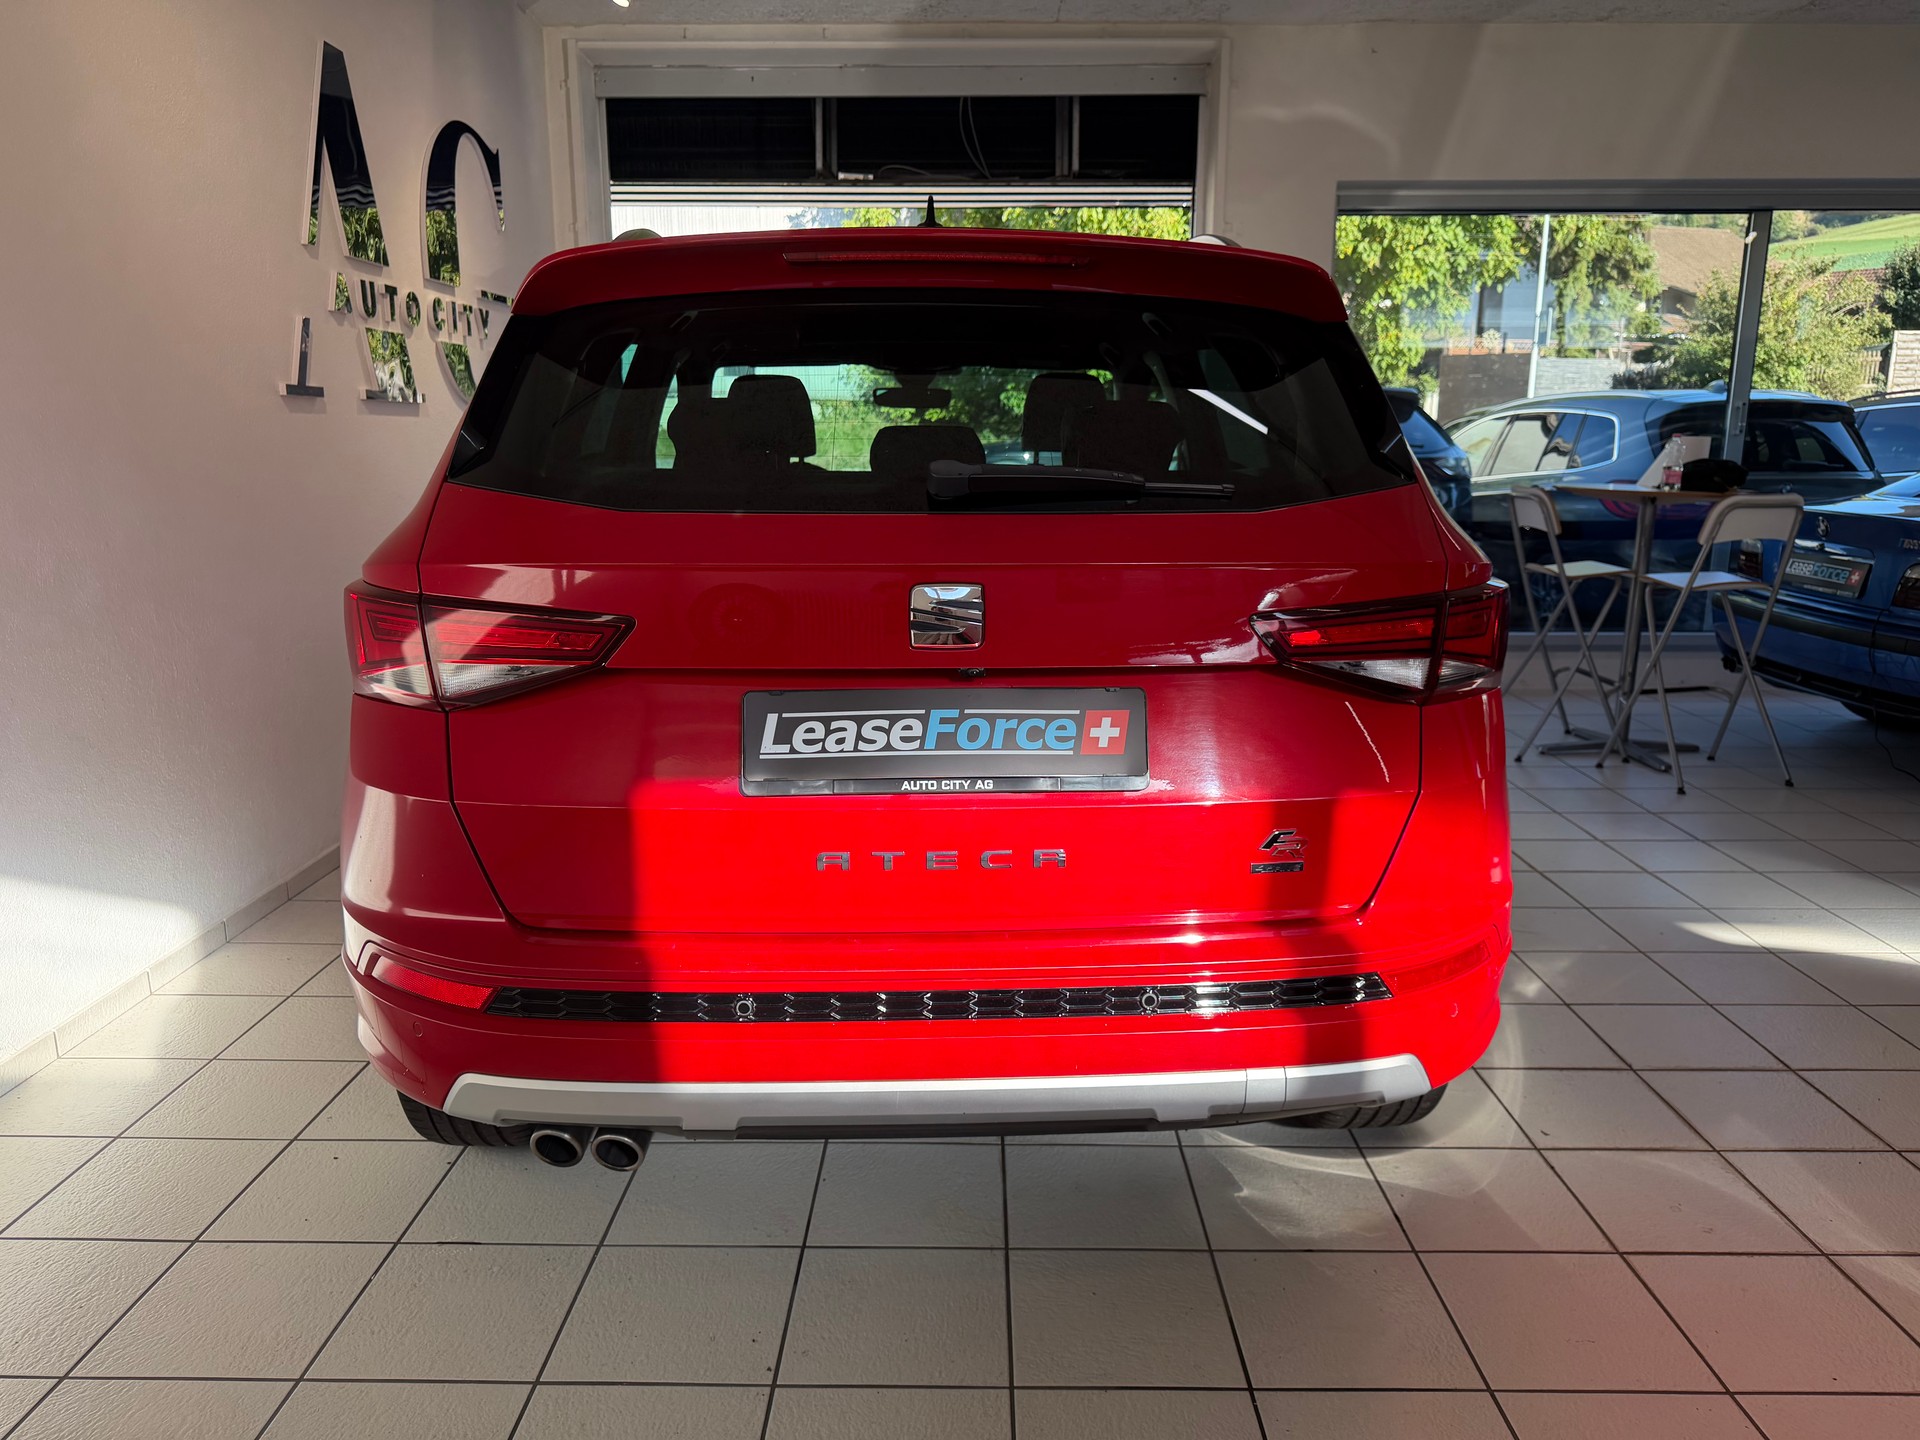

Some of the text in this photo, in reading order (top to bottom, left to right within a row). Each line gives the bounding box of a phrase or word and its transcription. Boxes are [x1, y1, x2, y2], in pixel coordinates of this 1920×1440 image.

[331, 272, 490, 340] AUTO CITY
[1785, 558, 1850, 581] LeaseForce
[759, 709, 1077, 754] LeaseForce
[901, 779, 994, 791] AUTO CITY AG
[1258, 829, 1308, 858] FR
[816, 849, 1066, 871] ATECA
